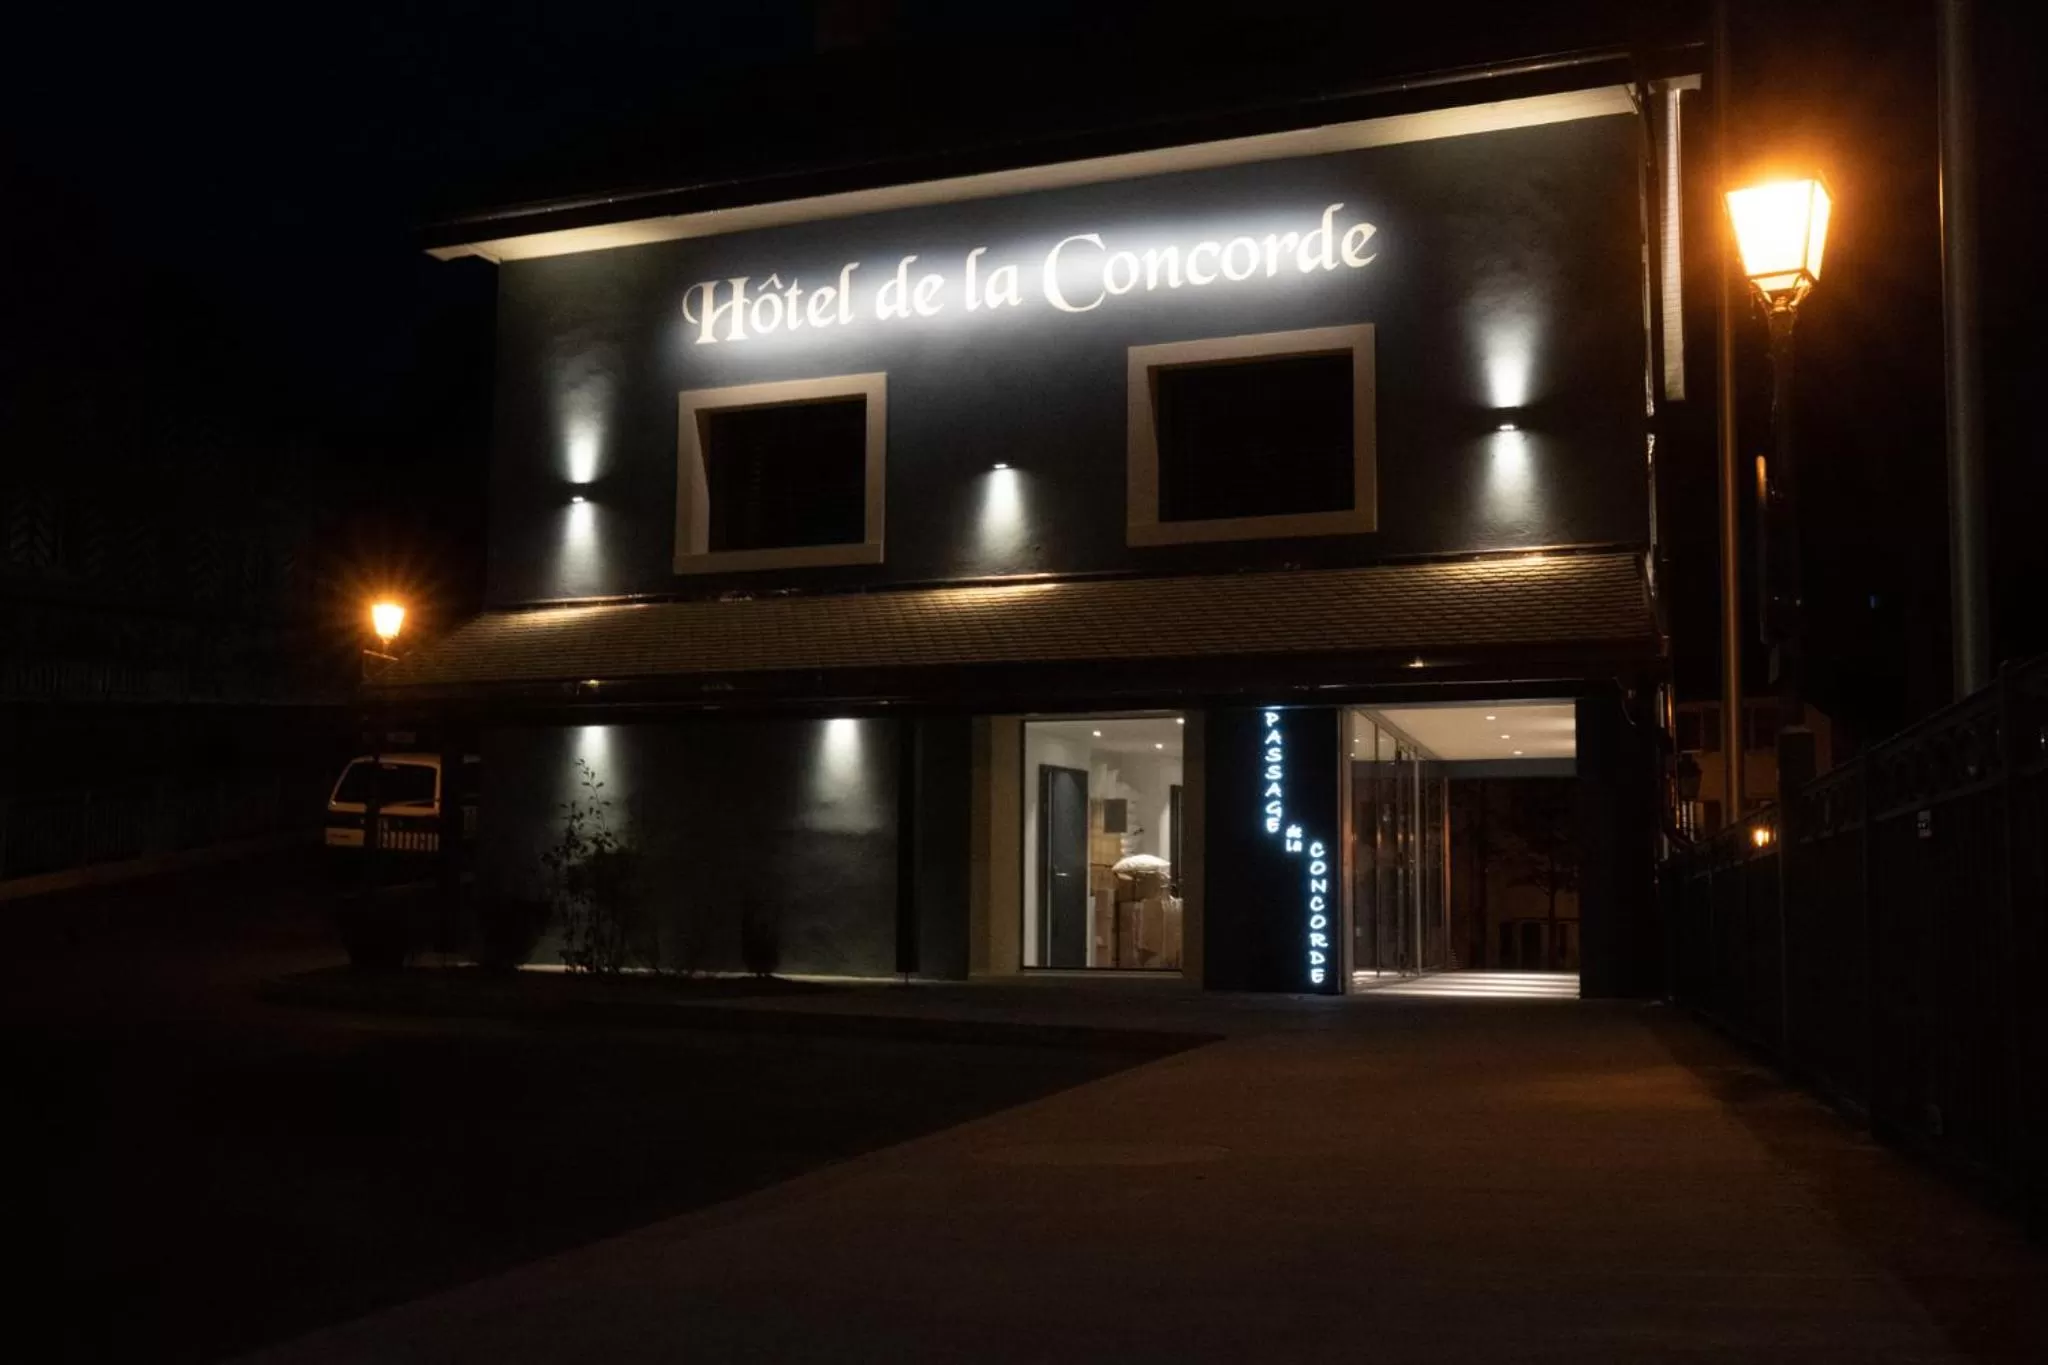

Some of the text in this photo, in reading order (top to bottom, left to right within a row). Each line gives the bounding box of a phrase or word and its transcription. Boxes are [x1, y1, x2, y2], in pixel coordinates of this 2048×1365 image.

[682, 202, 1378, 344] Hôtel de la Concorde
[1264, 711, 1283, 833] PASSAGE
[1309, 841, 1328, 984] CONCORDE
